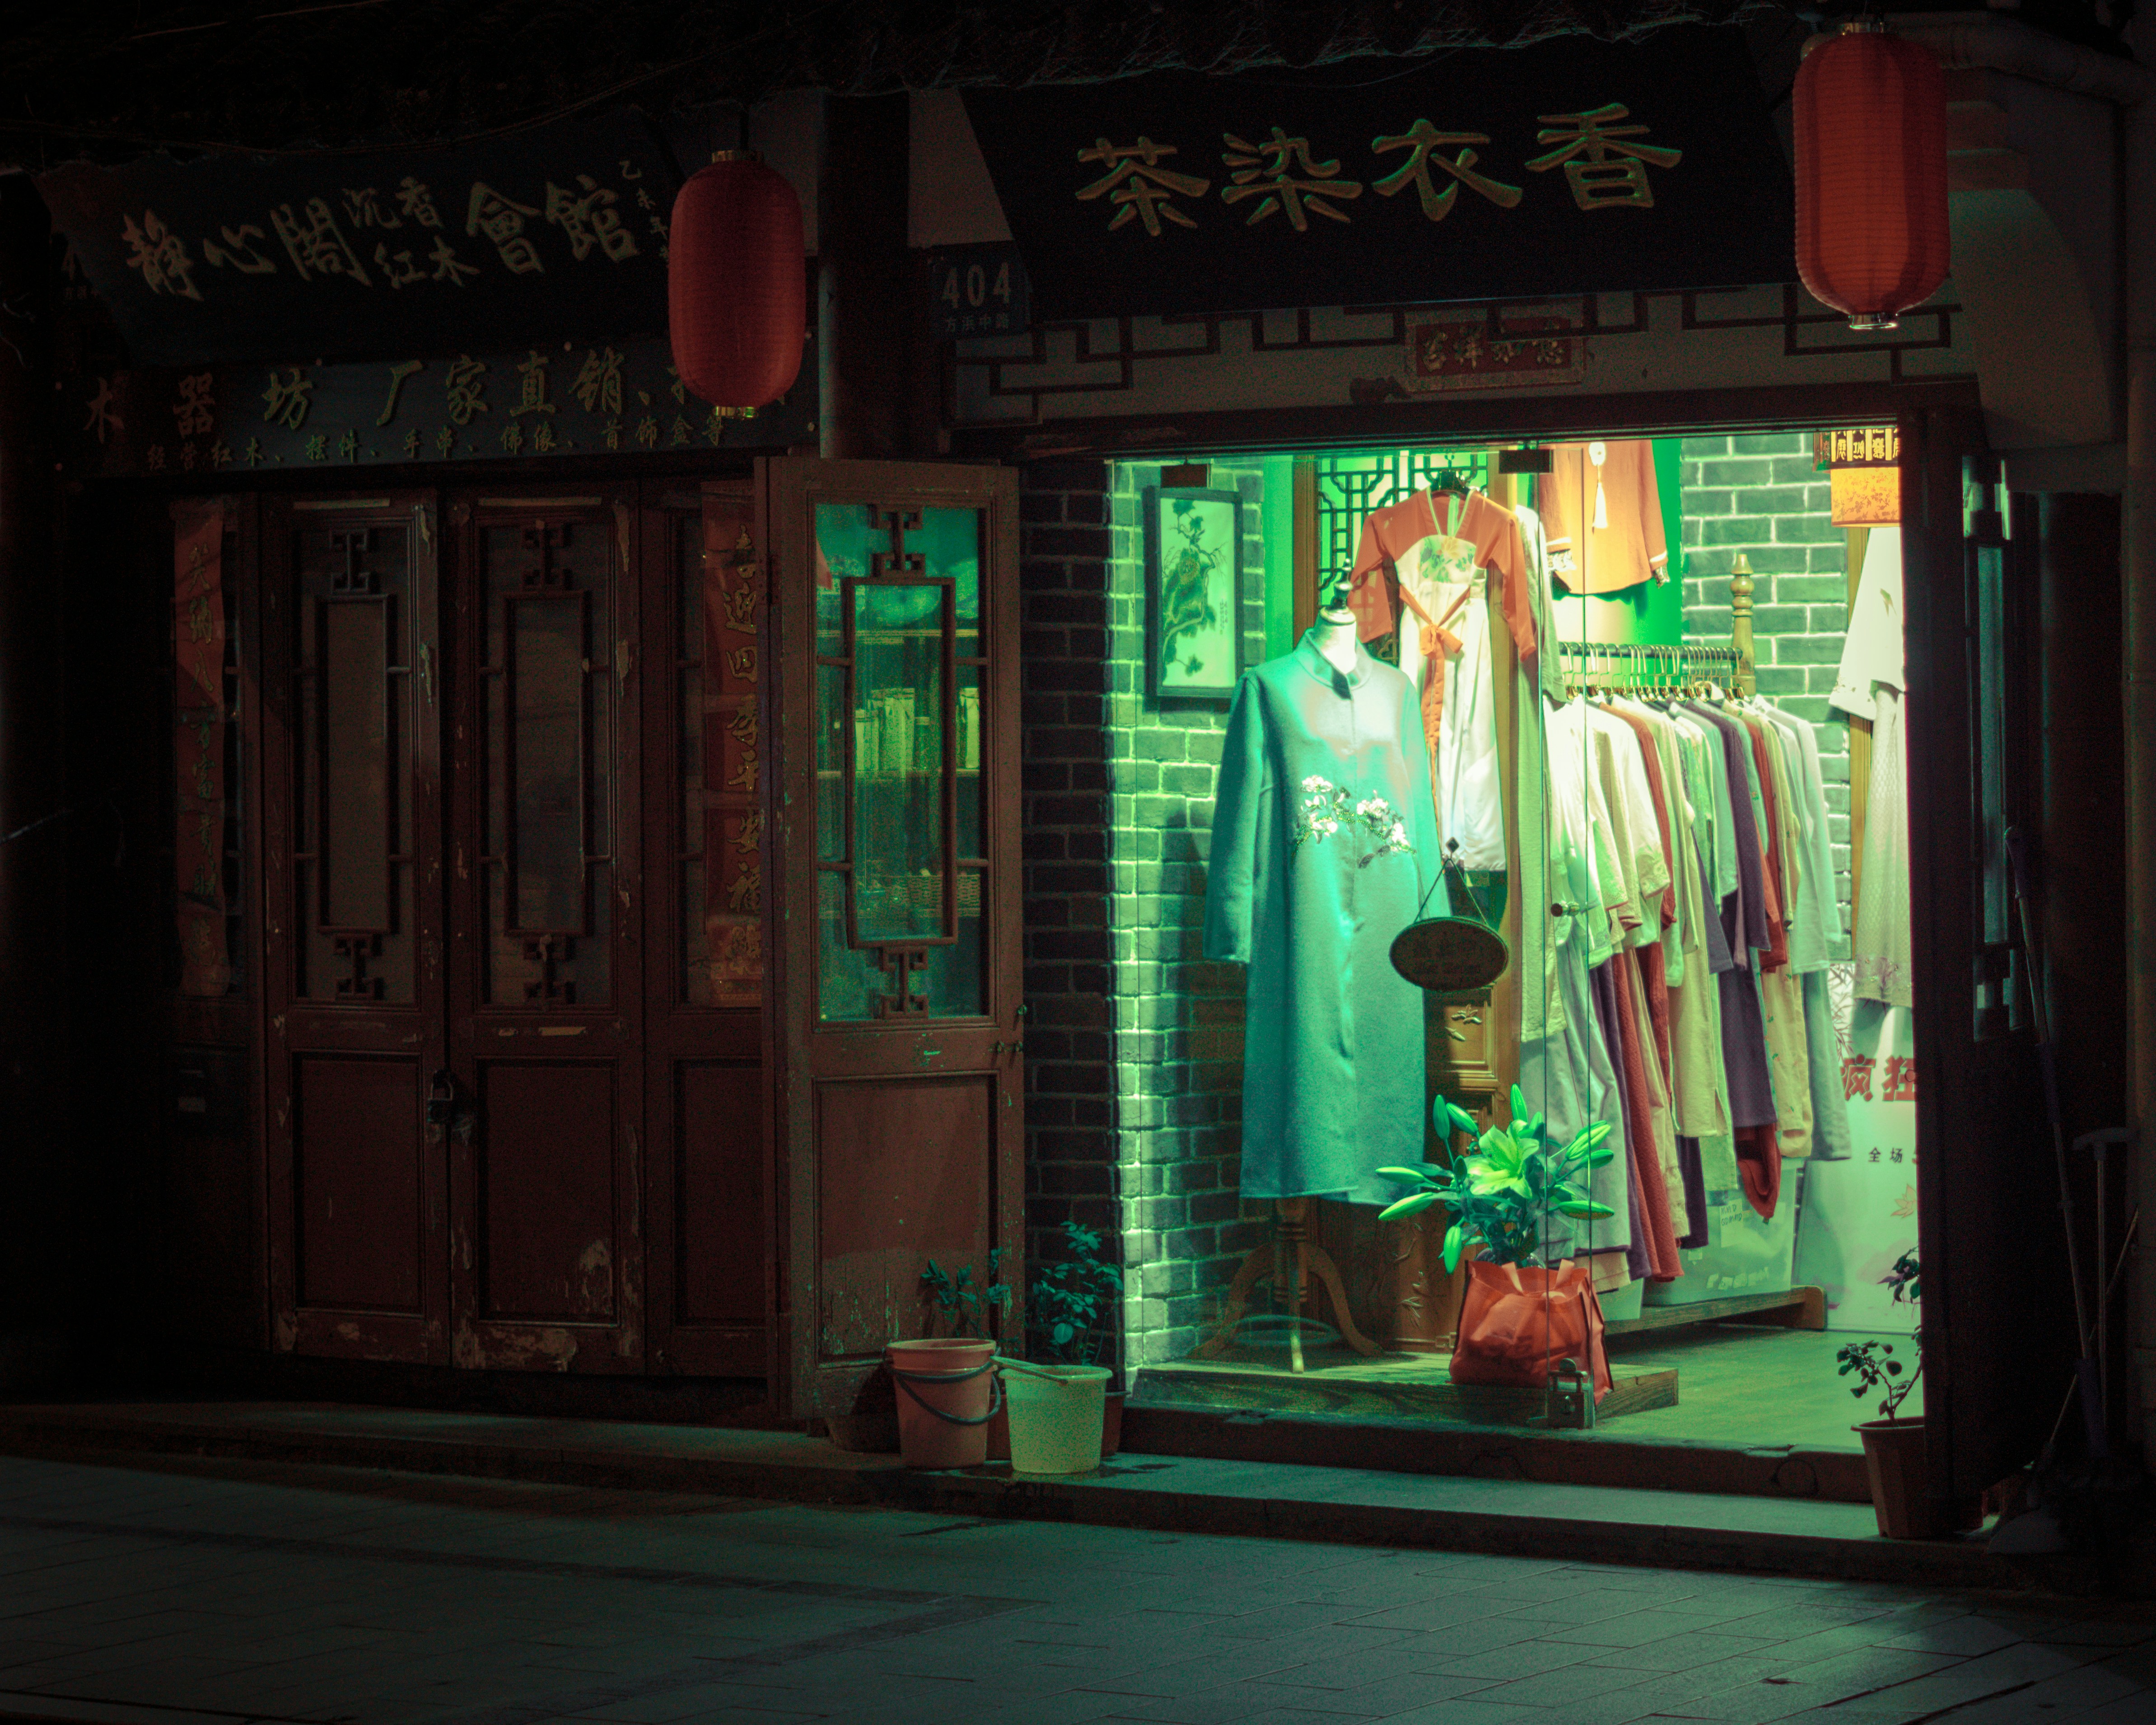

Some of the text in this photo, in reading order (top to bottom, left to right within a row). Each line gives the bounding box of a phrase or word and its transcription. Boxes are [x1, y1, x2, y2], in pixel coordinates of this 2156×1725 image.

[1074, 102, 1683, 237] 茶染衣香
[941, 260, 1012, 309] 404
[1839, 1053, 1916, 1102] 疯狂
